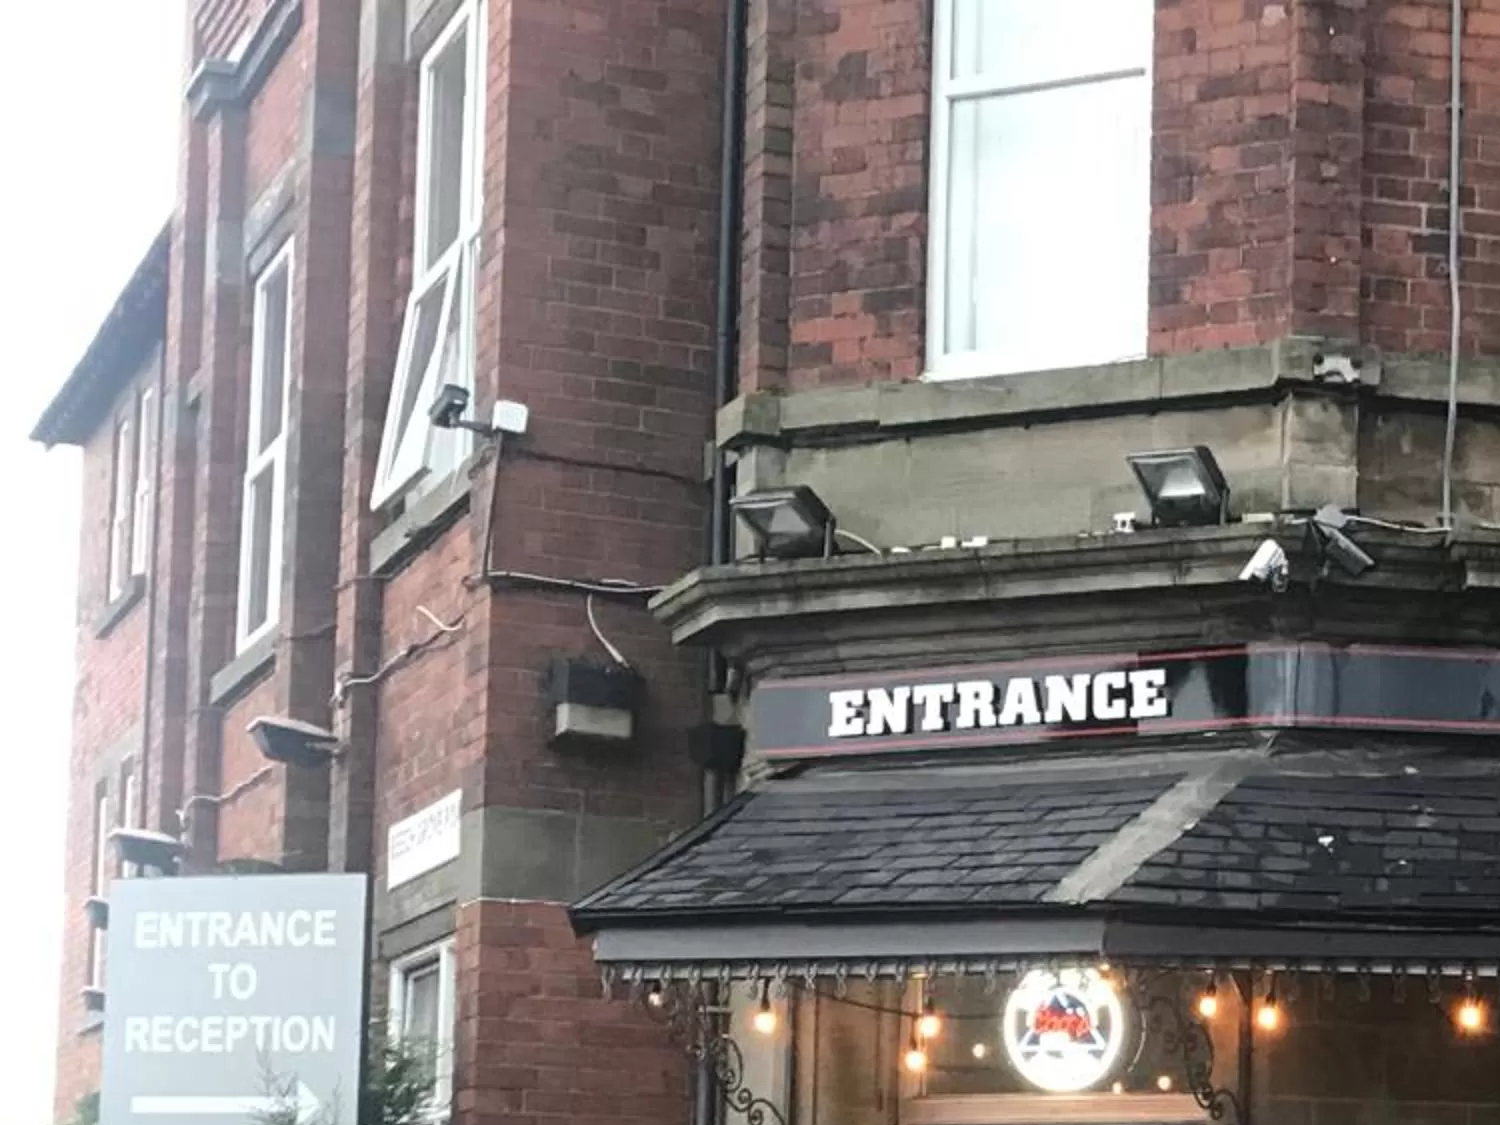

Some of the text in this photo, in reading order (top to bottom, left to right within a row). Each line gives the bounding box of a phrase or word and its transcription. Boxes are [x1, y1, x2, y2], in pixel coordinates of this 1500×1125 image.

[829, 668, 1167, 737] ENTRANCE
[135, 910, 337, 948] ENTRANCE
[208, 963, 257, 1000] TO
[126, 1016, 336, 1053] RECEPTION
